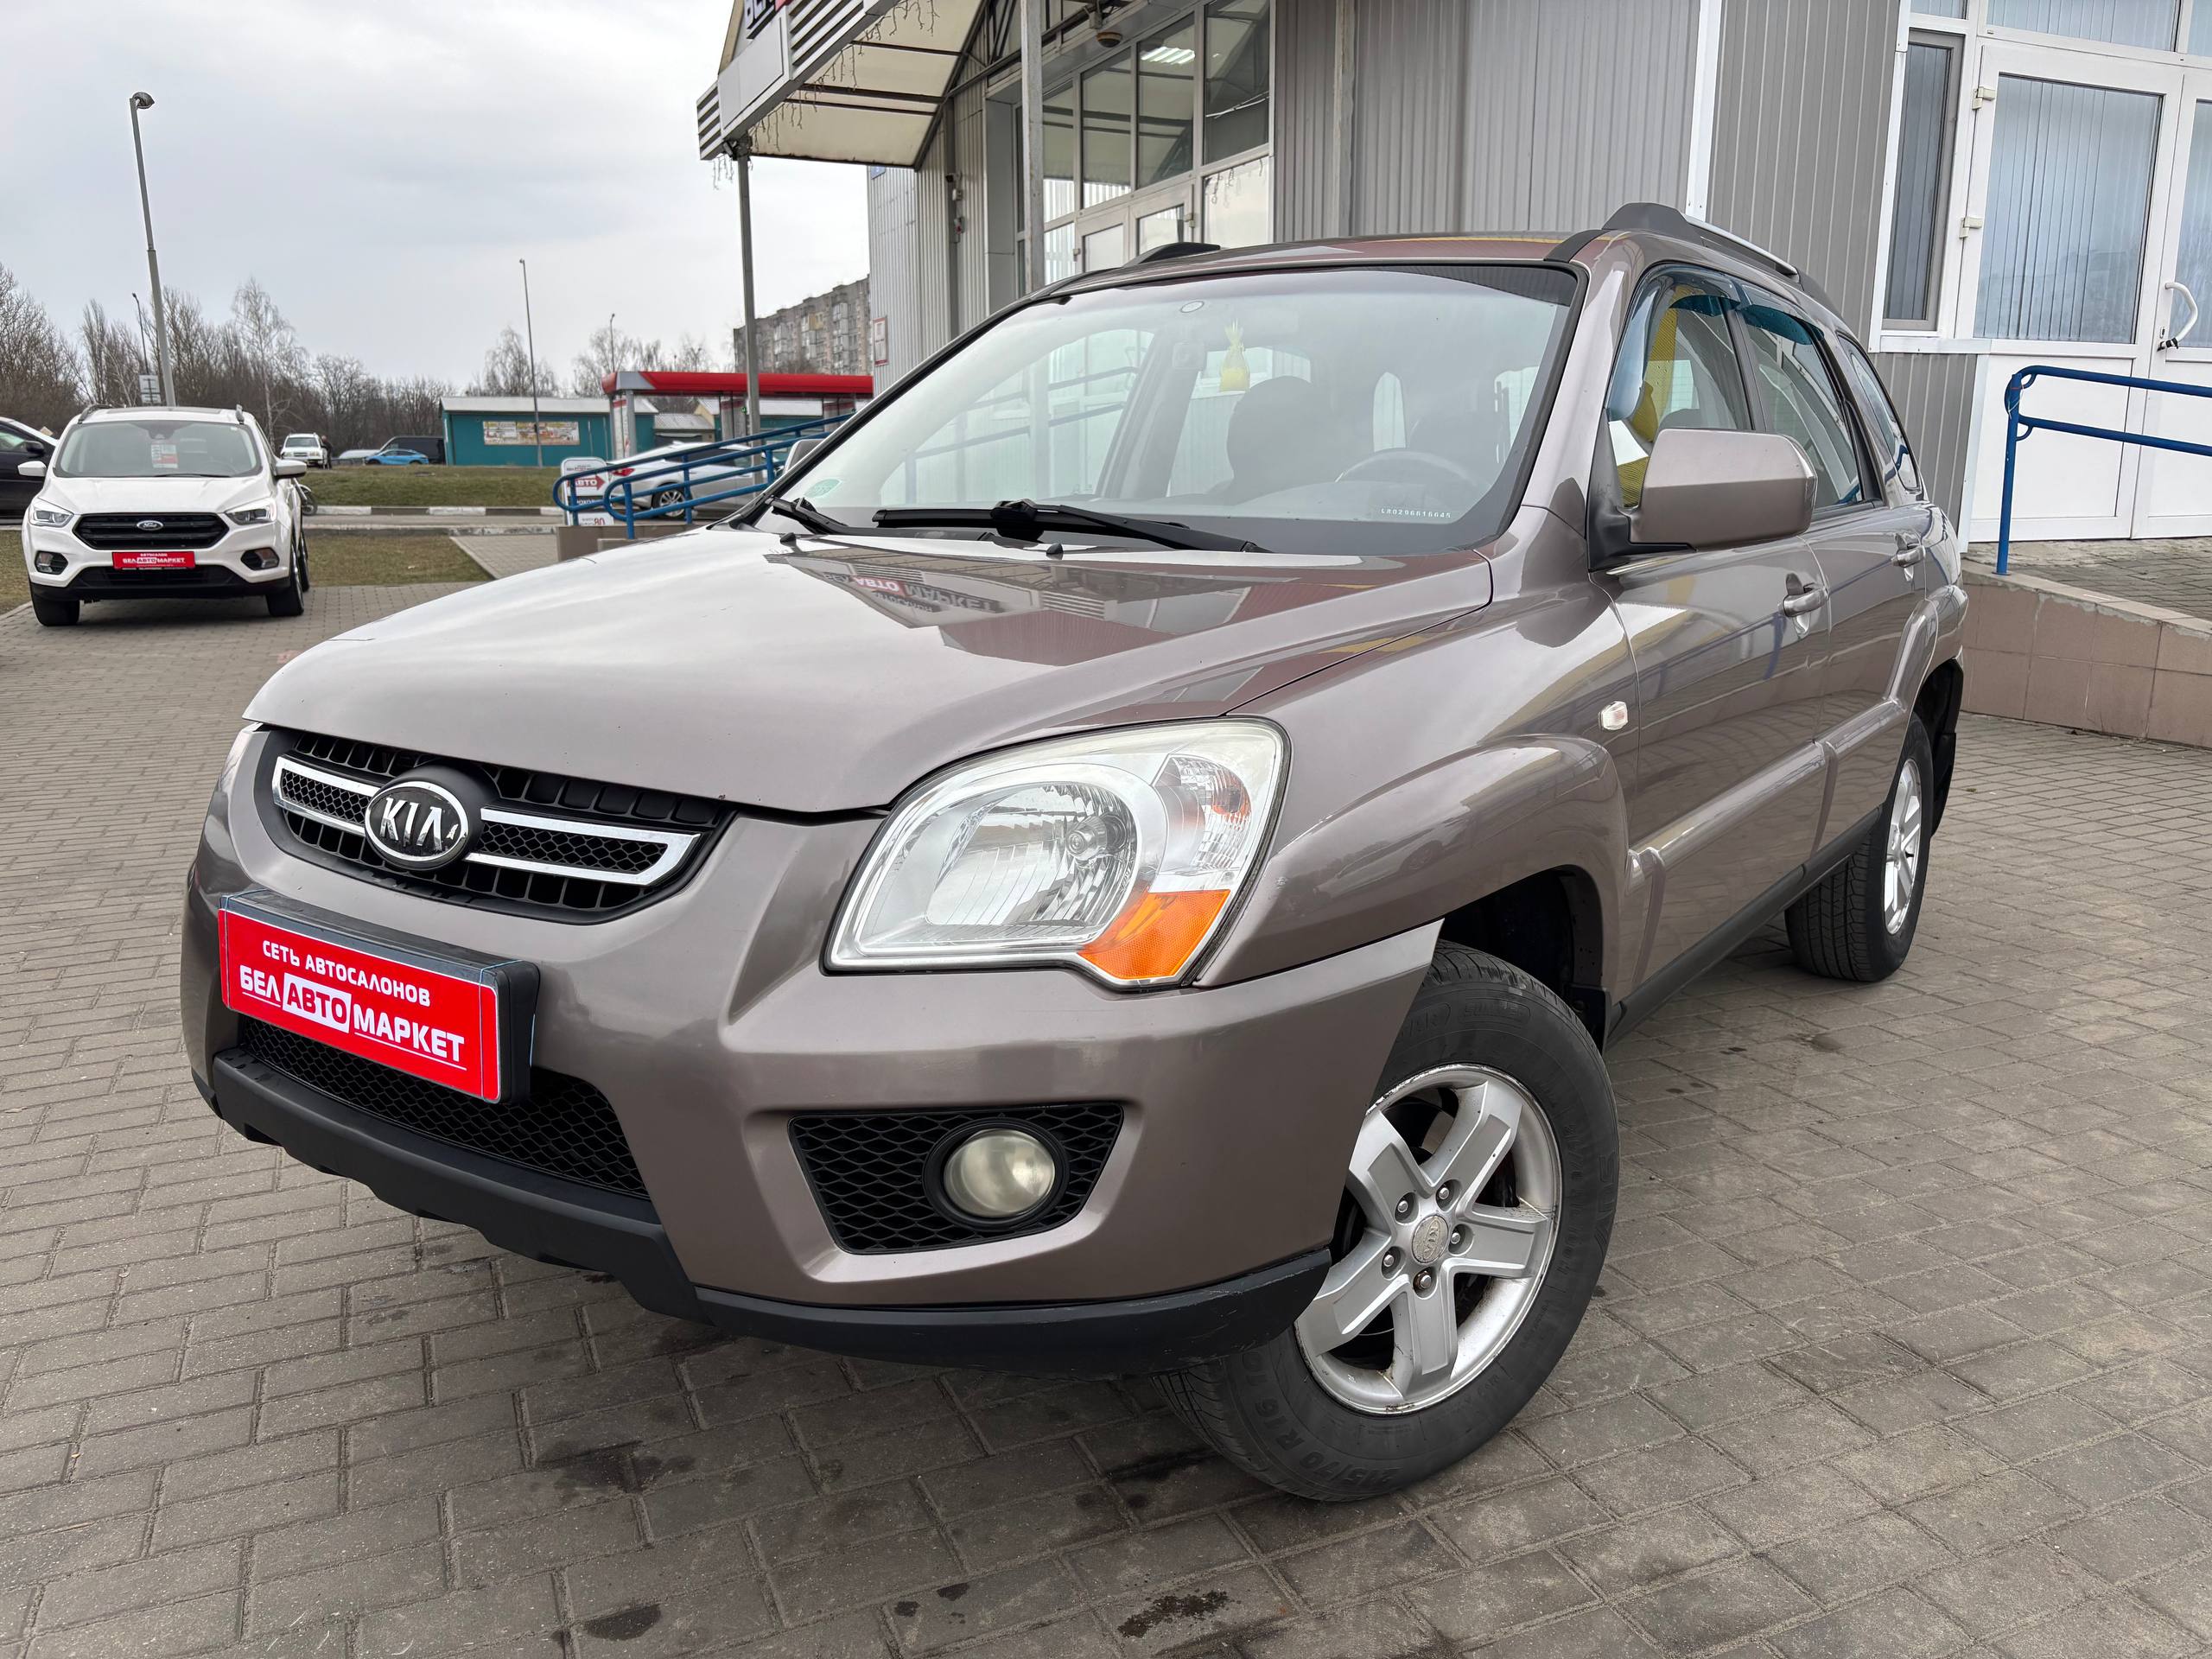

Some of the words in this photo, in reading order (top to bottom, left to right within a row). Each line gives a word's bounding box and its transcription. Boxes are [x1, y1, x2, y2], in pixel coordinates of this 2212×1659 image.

[379, 797, 458, 852] KIA
[263, 940, 300, 966] СЕТЬ
[305, 954, 430, 1007] АВТОСАЛОНОВ
